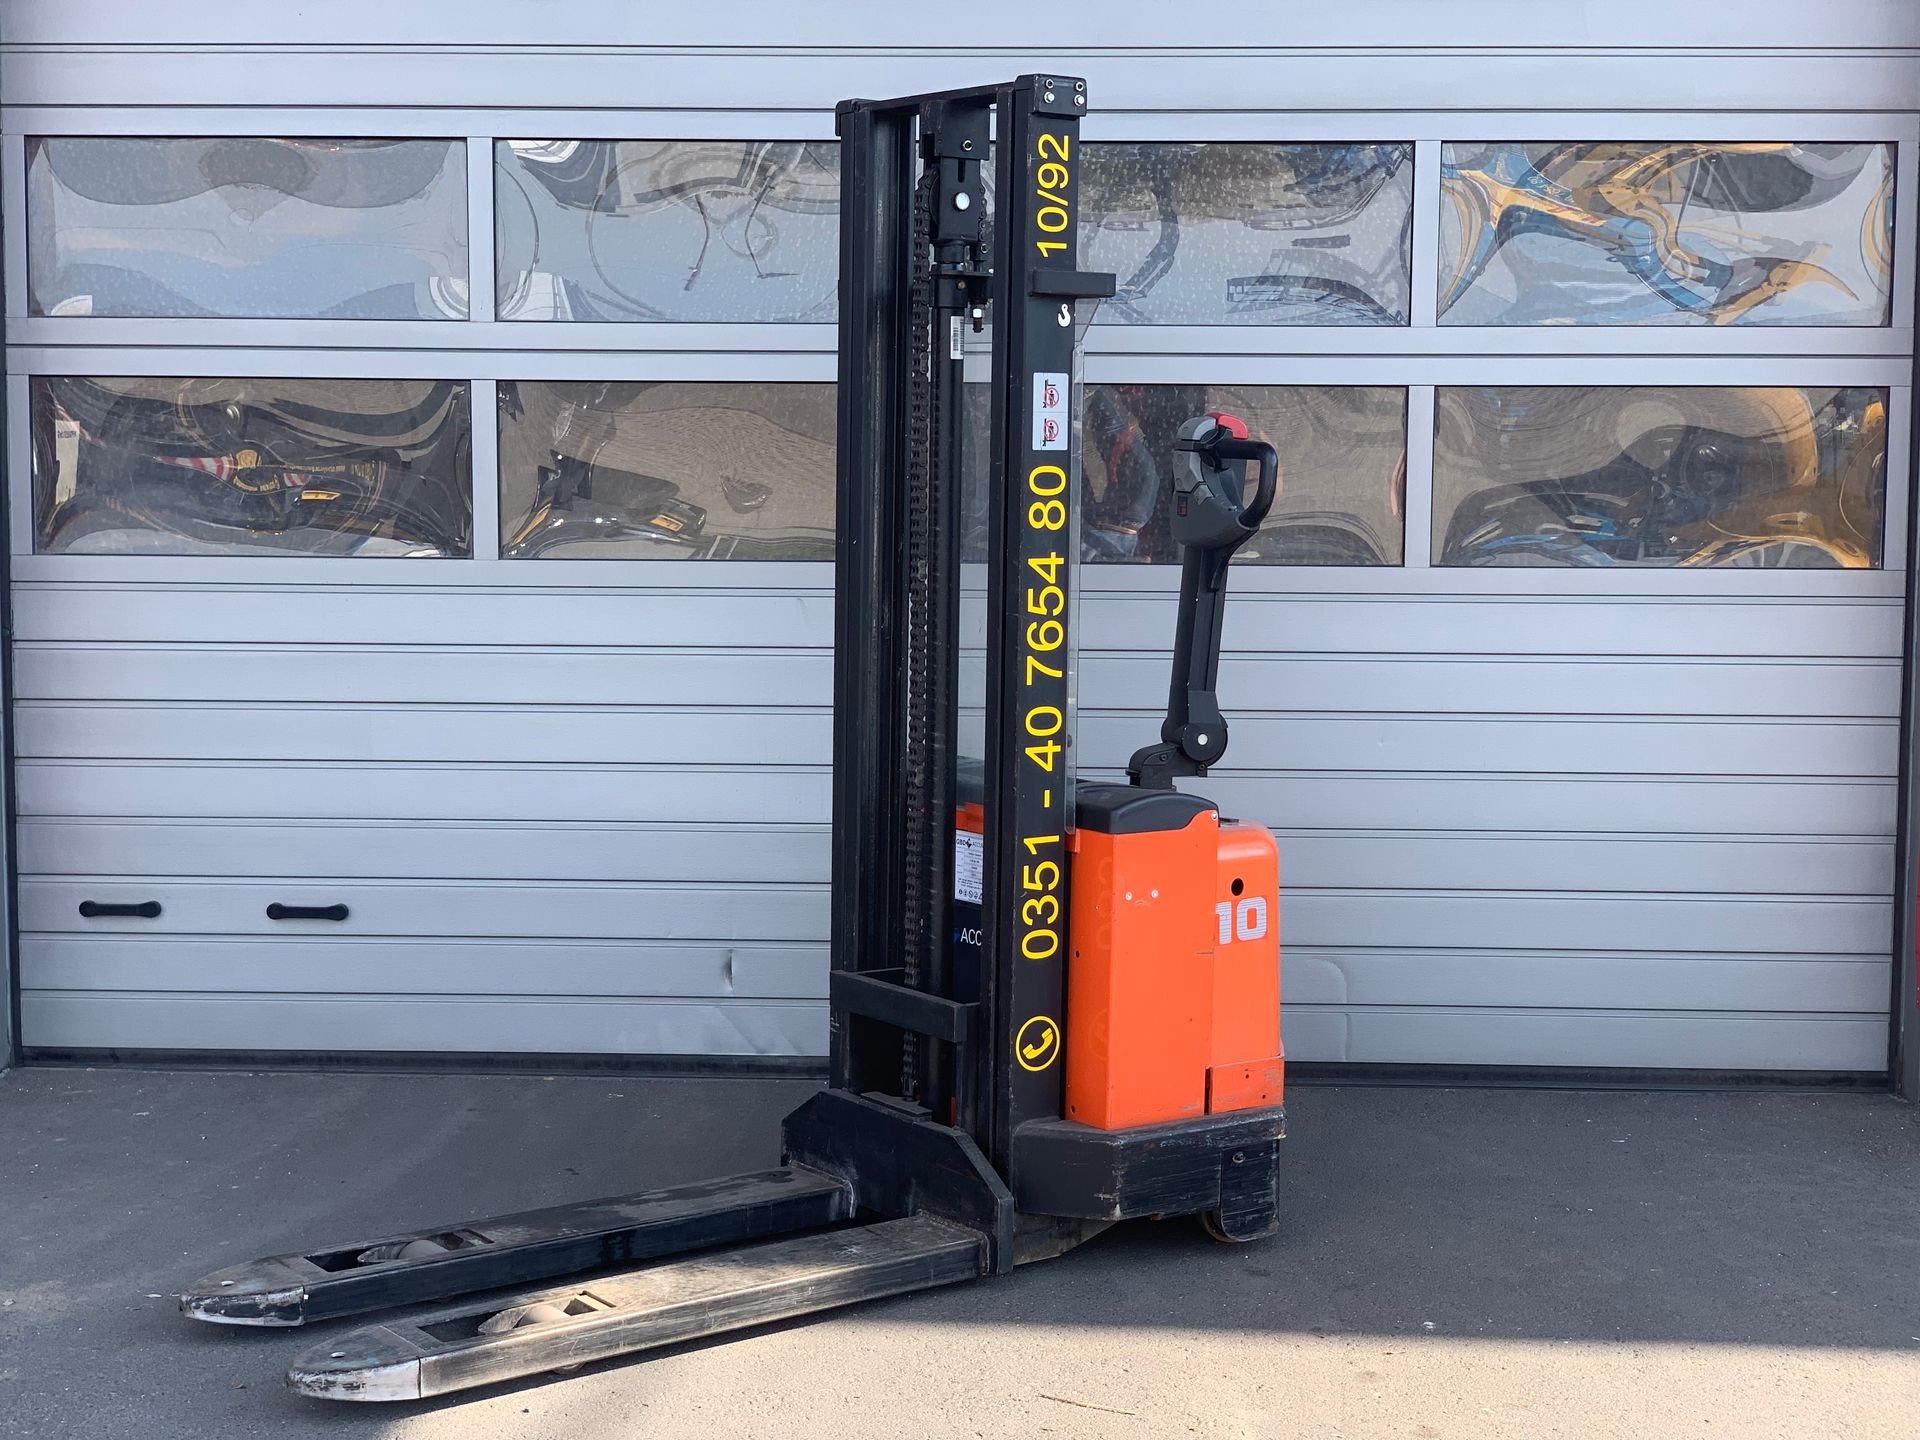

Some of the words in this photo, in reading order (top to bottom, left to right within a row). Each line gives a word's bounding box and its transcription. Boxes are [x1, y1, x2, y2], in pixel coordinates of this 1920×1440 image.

[1037, 133, 1069, 257] 10/92
[1028, 465, 1067, 530] 80
[1026, 552, 1064, 686] 7654
[1025, 706, 1062, 771] 40
[1021, 835, 1060, 960] 0351
[1215, 896, 1267, 944] 10
